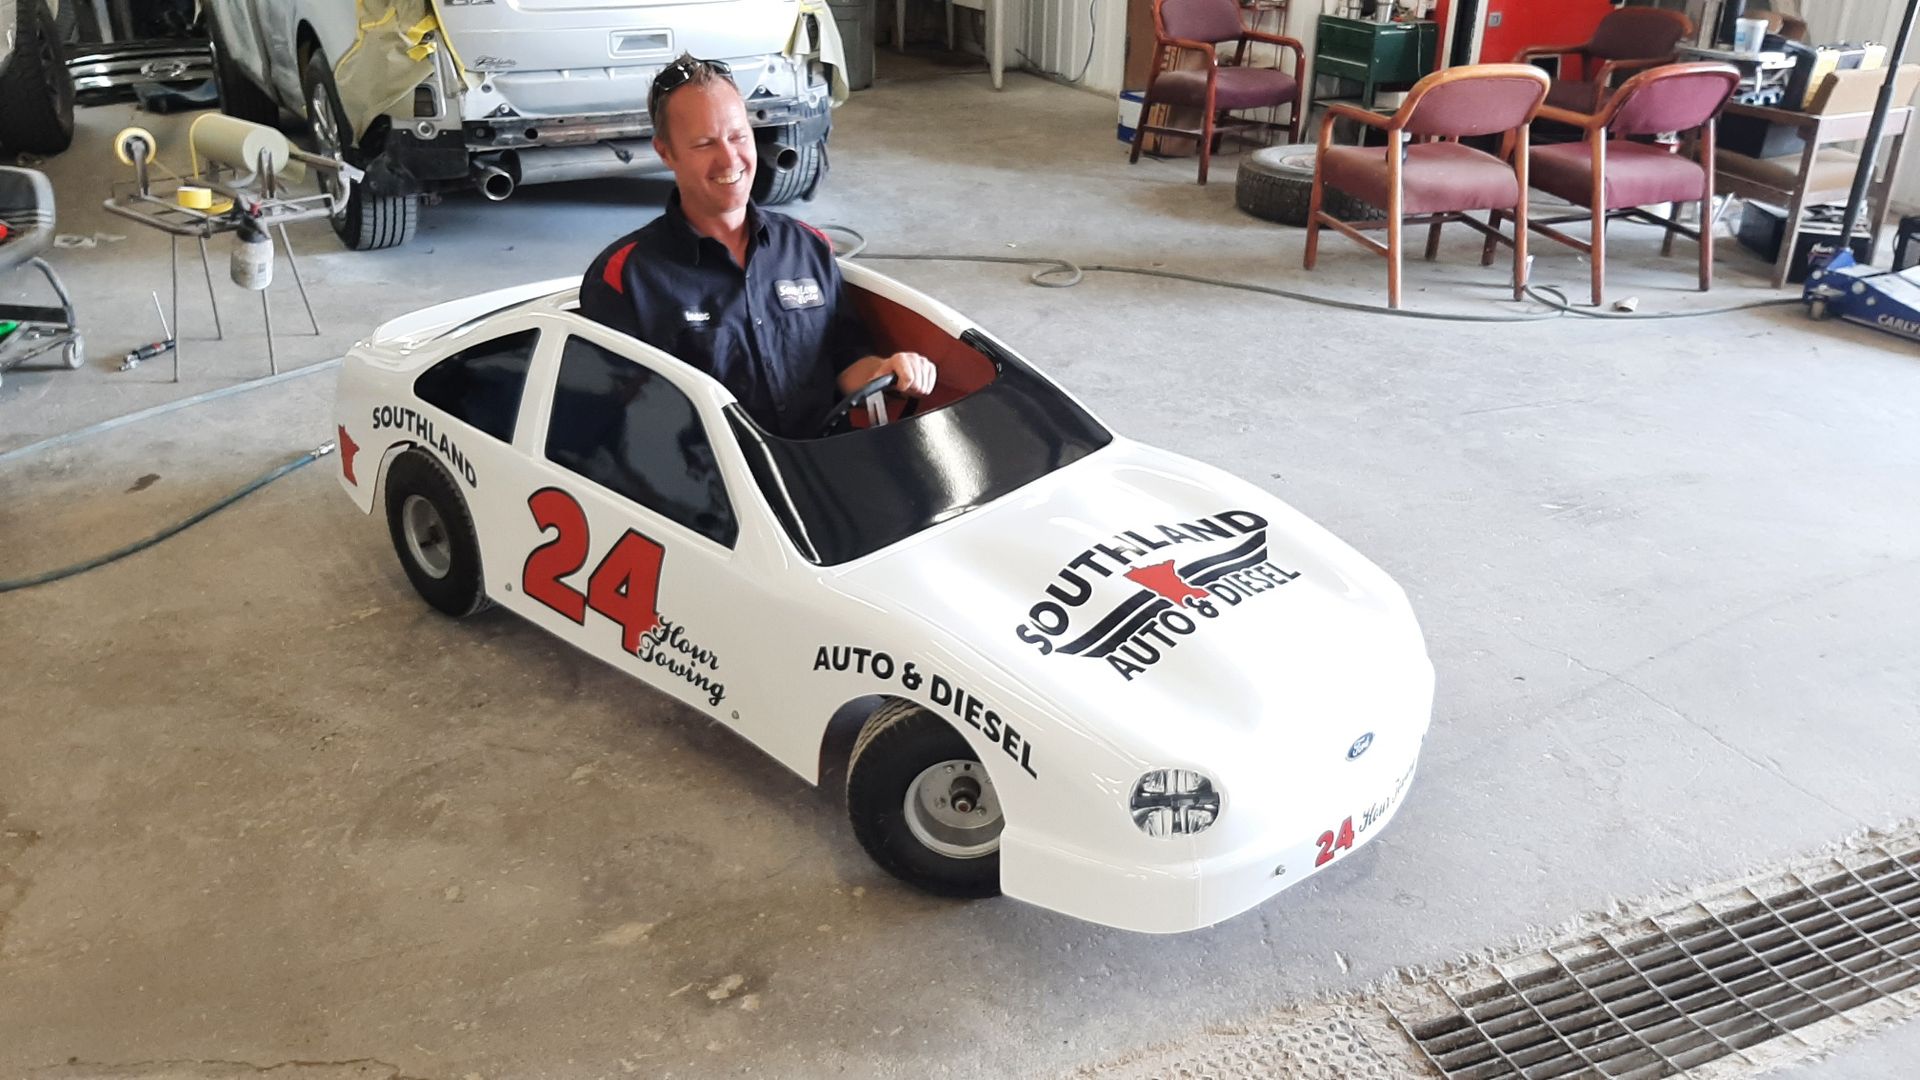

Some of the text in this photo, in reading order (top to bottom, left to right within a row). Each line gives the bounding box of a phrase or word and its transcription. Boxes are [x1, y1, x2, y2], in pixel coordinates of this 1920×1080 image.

[373, 405, 477, 488] SOUTHLAND
[522, 486, 666, 657] 24
[1016, 510, 1268, 656] SOUTHLAND
[652, 614, 719, 670] Hour
[1105, 562, 1301, 681] AUTO & DIESEL
[638, 632, 726, 706] Towing
[813, 646, 1037, 780] AUTO & DIESEL
[1350, 733, 1371, 757] Ford
[1315, 815, 1355, 868] 24
[1359, 797, 1389, 832] Hour
